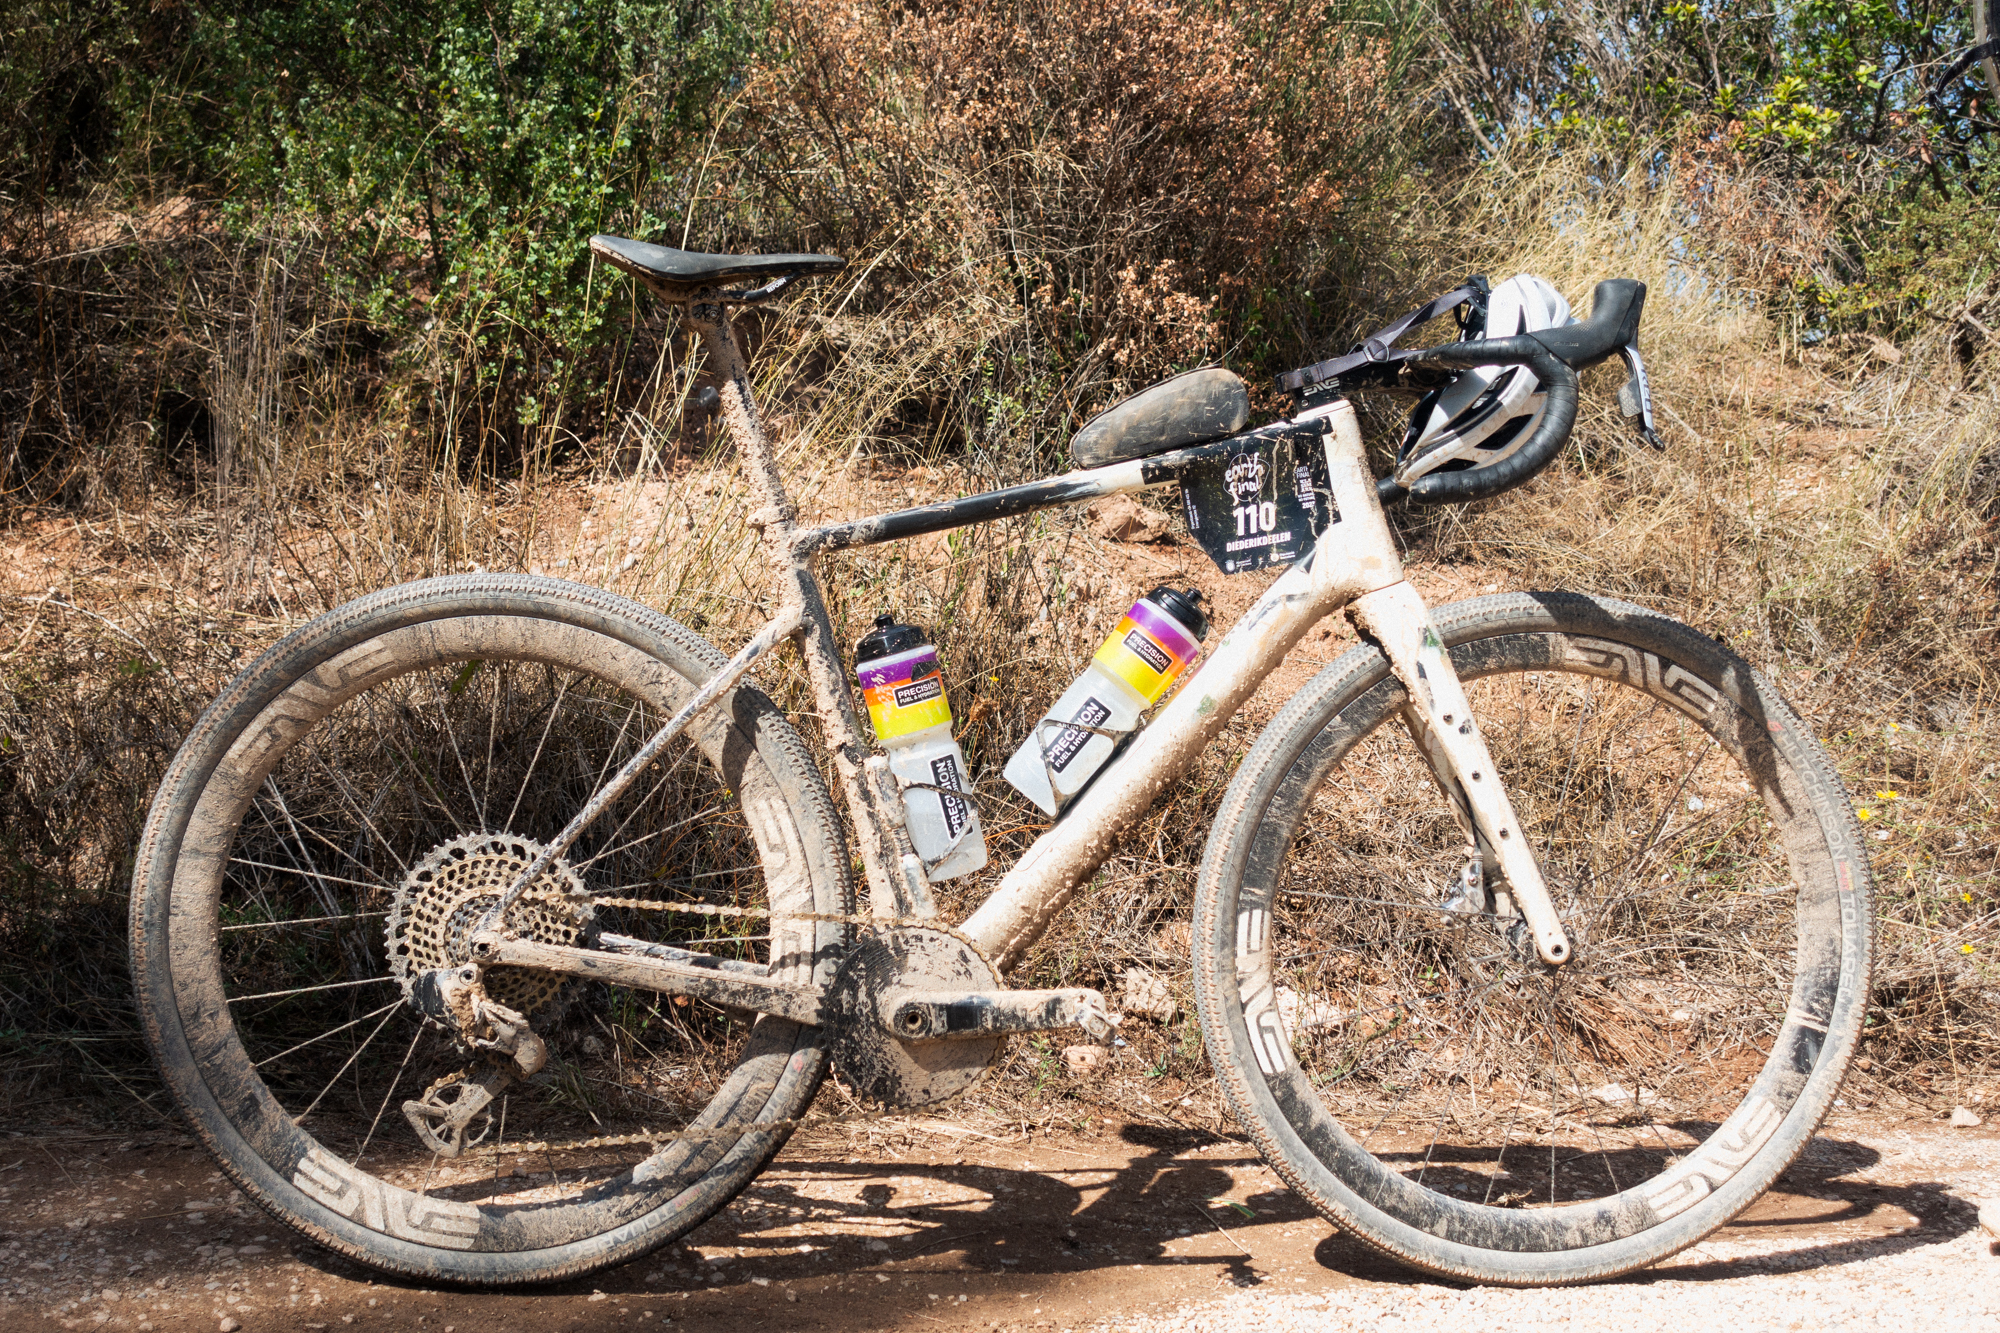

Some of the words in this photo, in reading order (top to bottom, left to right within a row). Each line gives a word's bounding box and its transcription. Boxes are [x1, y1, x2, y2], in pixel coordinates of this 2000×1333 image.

[1225, 452, 1265, 482] earth
[1228, 474, 1263, 506] final
[1232, 501, 1276, 536] 110
[1226, 531, 1291, 552] DIEDERIKDEELEN
[1126, 639, 1138, 650] FUEL
[1130, 633, 1169, 667] PRECISION
[898, 681, 939, 698] PRECISION
[900, 696, 914, 704] FUEL
[1046, 701, 1100, 763] PRECIION
[1054, 751, 1072, 768] FUEL
[1068, 744, 1076, 752] &
[1778, 731, 1848, 861] HUTCHINSON
